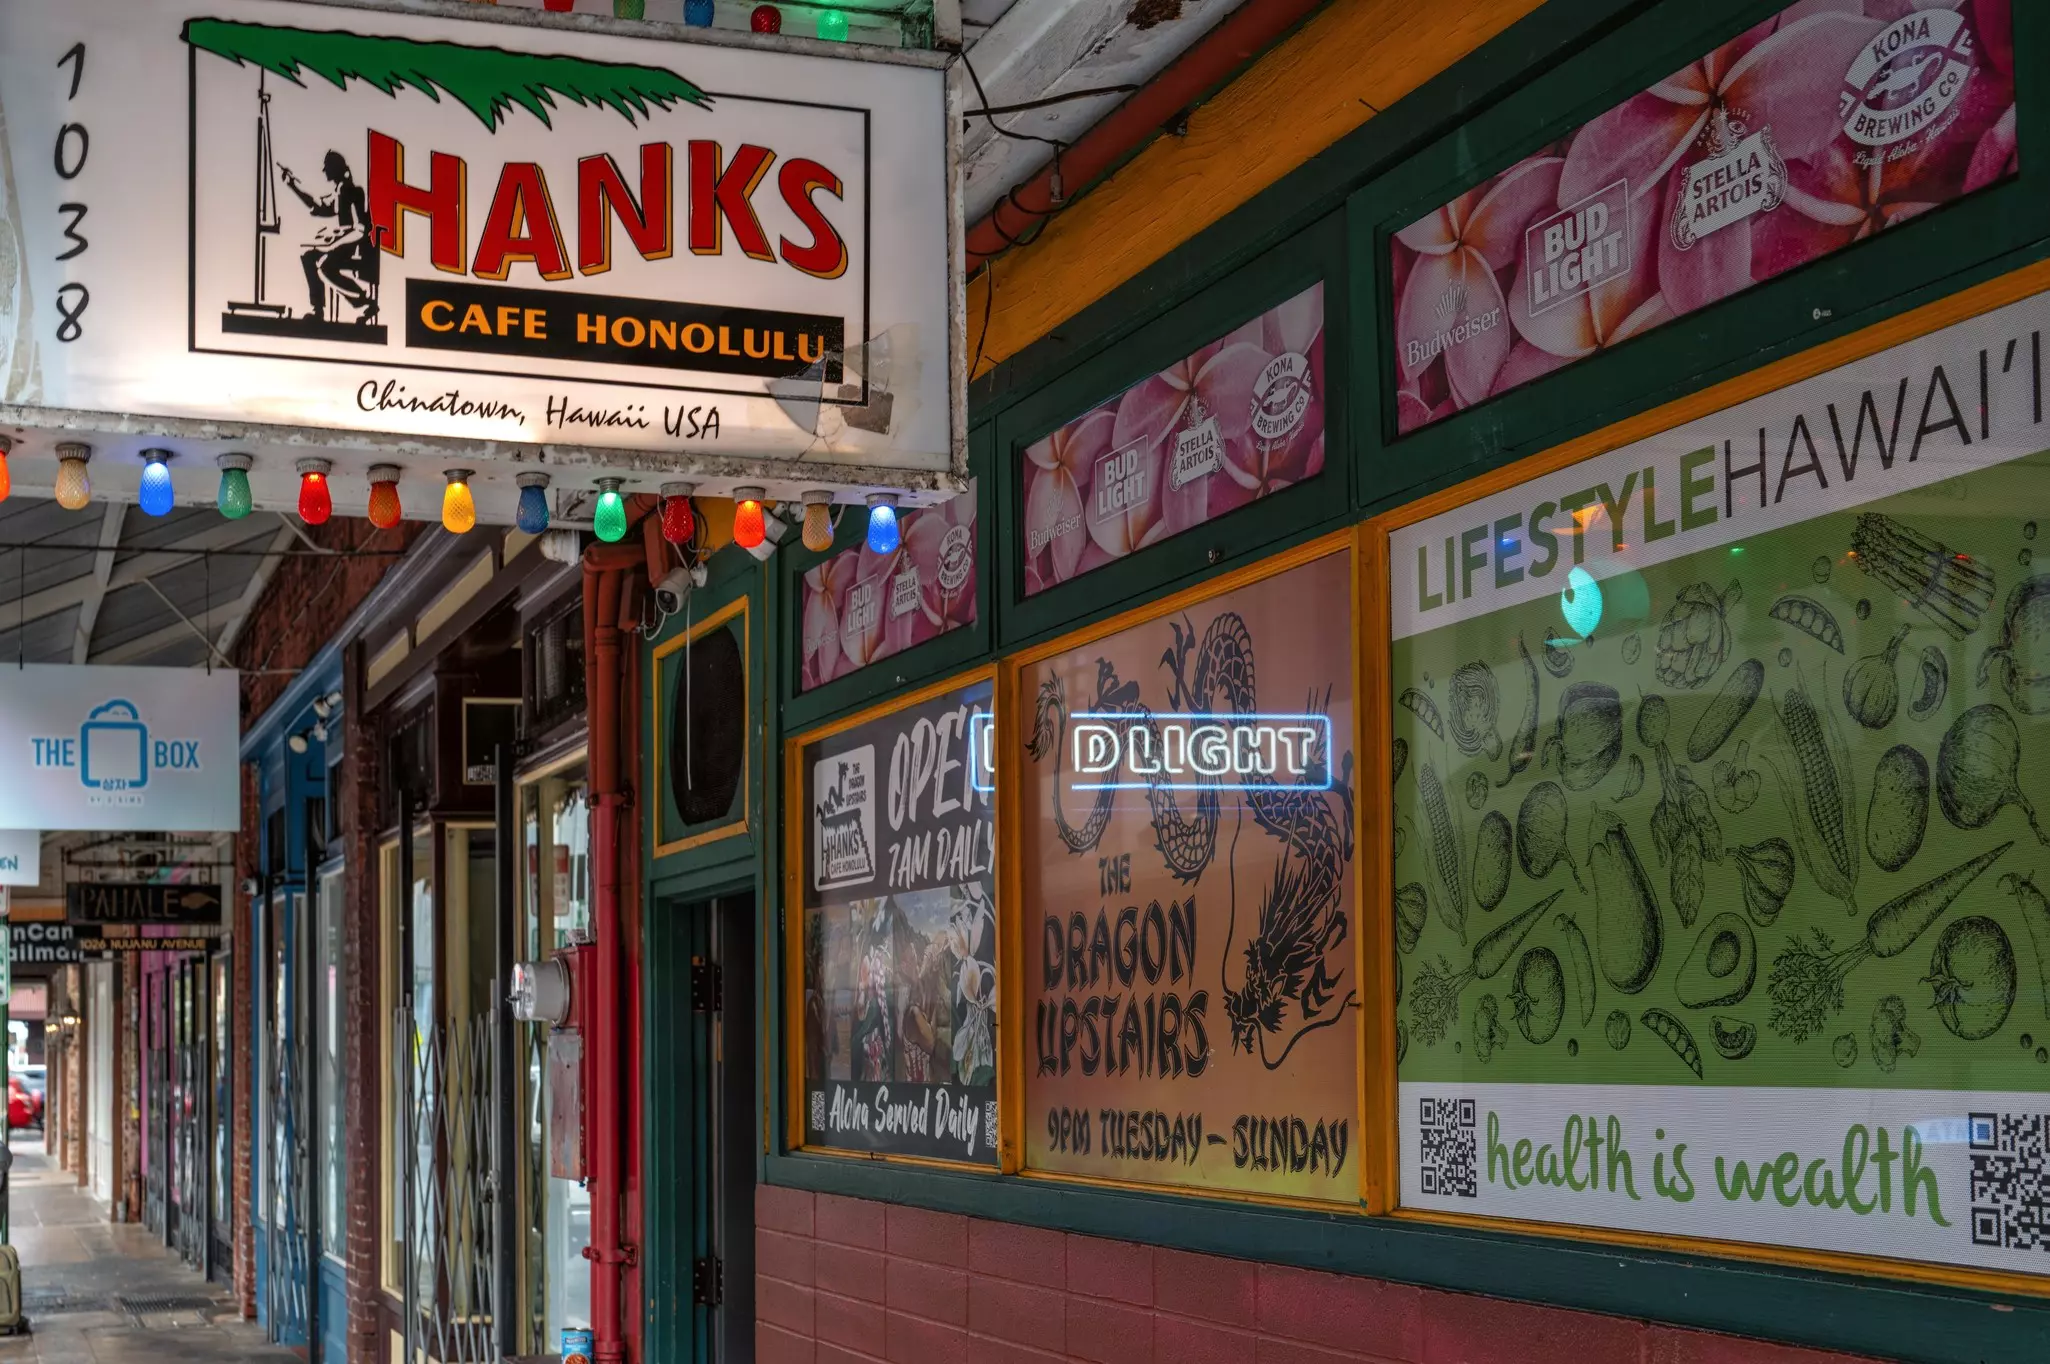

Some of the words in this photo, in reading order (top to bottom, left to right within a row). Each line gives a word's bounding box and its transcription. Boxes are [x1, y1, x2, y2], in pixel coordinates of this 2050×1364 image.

[1872, 17, 1930, 63] KONA
[1854, 96, 1936, 139] BREWING
[1692, 151, 1762, 200] STELLA
[367, 129, 848, 281] HANKS
[1692, 173, 1763, 223] ARTOIS
[1544, 201, 1609, 264] BUD
[1533, 230, 1622, 305] LIGHT
[420, 299, 548, 341] CAFE
[576, 313, 824, 364] HONOLULU
[1406, 307, 1500, 368] Budweiser
[1266, 357, 1293, 383] KONA
[356, 379, 526, 427] Chinatown,
[546, 394, 650, 430] Hawaii
[664, 406, 721, 440] USA
[1256, 410, 1295, 434] BREWING
[1179, 445, 1214, 474] ARTOIS
[1180, 430, 1213, 457] STELLA
[1104, 449, 1138, 486] BUD
[1098, 470, 1145, 516] LIGHT
[946, 529, 963, 545] KONA
[1030, 513, 1081, 550] Budweiser
[851, 584, 872, 610] BUD
[895, 577, 917, 593] STELLA
[941, 570, 963, 586] BREWING
[847, 602, 876, 633] LIGHT
[894, 590, 917, 607] ARTOIS
[31, 738, 75, 766] THE
[154, 741, 199, 769] BOX
[852, 762, 860, 775] THE
[845, 789, 867, 807] UPSTAIRS
[829, 829, 860, 861] HANKS
[888, 829, 932, 890] 7AM
[830, 861, 843, 875] CAFE
[842, 856, 866, 873] HONOLULU
[1099, 852, 1132, 896] THE
[80, 938, 106, 950] 1026
[110, 938, 158, 950] NUUANU
[161, 938, 206, 950] AVENUE
[1042, 895, 1198, 992] DRAGON
[1036, 990, 1213, 1081] UPSTAIRS
[829, 1083, 869, 1133] Aloha
[874, 1085, 931, 1137] Served
[935, 1087, 979, 1157] Daily
[1048, 1105, 1091, 1155] 9PM
[1099, 1107, 1202, 1167] TUESDAY
[1232, 1113, 1349, 1179] SUNDAY
[1486, 1110, 1642, 1201] health
[1654, 1128, 1696, 1203] is
[1714, 1123, 1953, 1228] wealth
